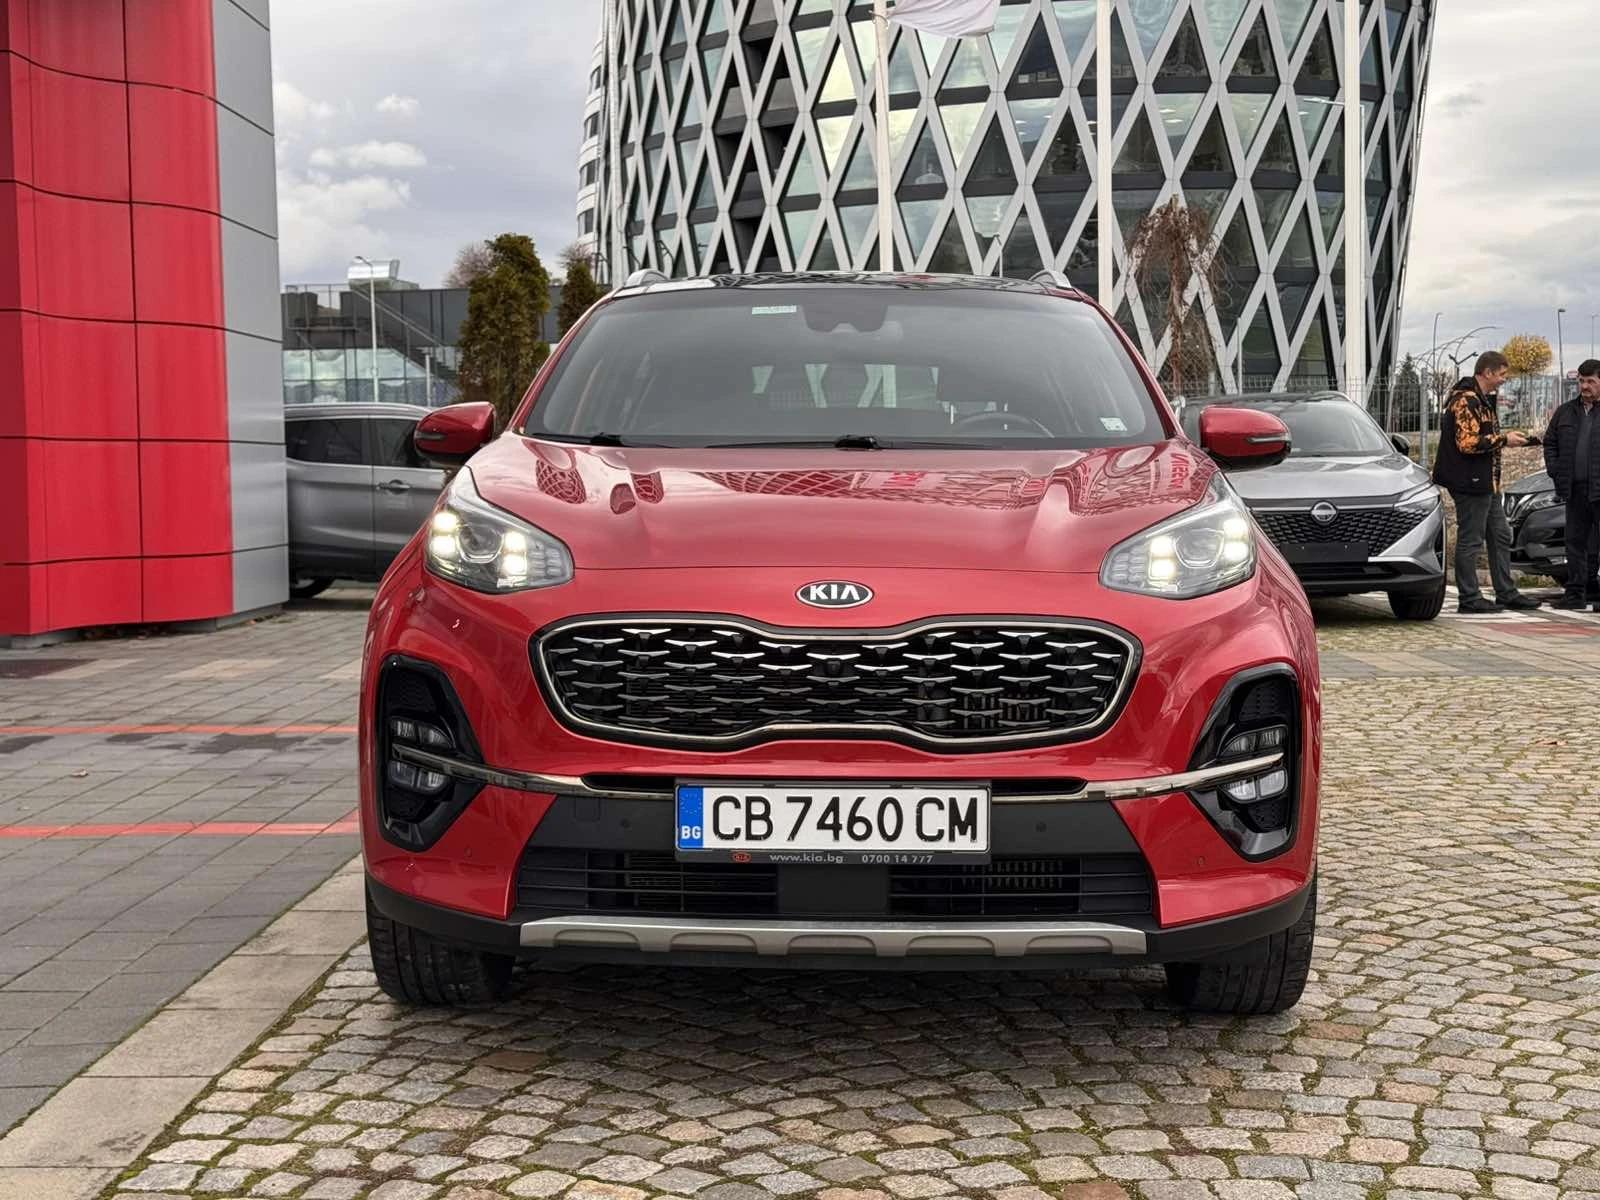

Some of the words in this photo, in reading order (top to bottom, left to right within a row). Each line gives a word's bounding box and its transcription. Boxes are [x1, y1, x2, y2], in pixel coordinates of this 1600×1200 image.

[809, 583, 860, 601] KIA
[712, 795, 774, 841] CB
[785, 796, 904, 842] 7460
[915, 797, 978, 843] CM
[681, 825, 702, 840] BG
[769, 852, 844, 864] www.kia.bg
[861, 854, 891, 864] 0700
[894, 854, 908, 863] 14
[911, 854, 934, 864] 777
